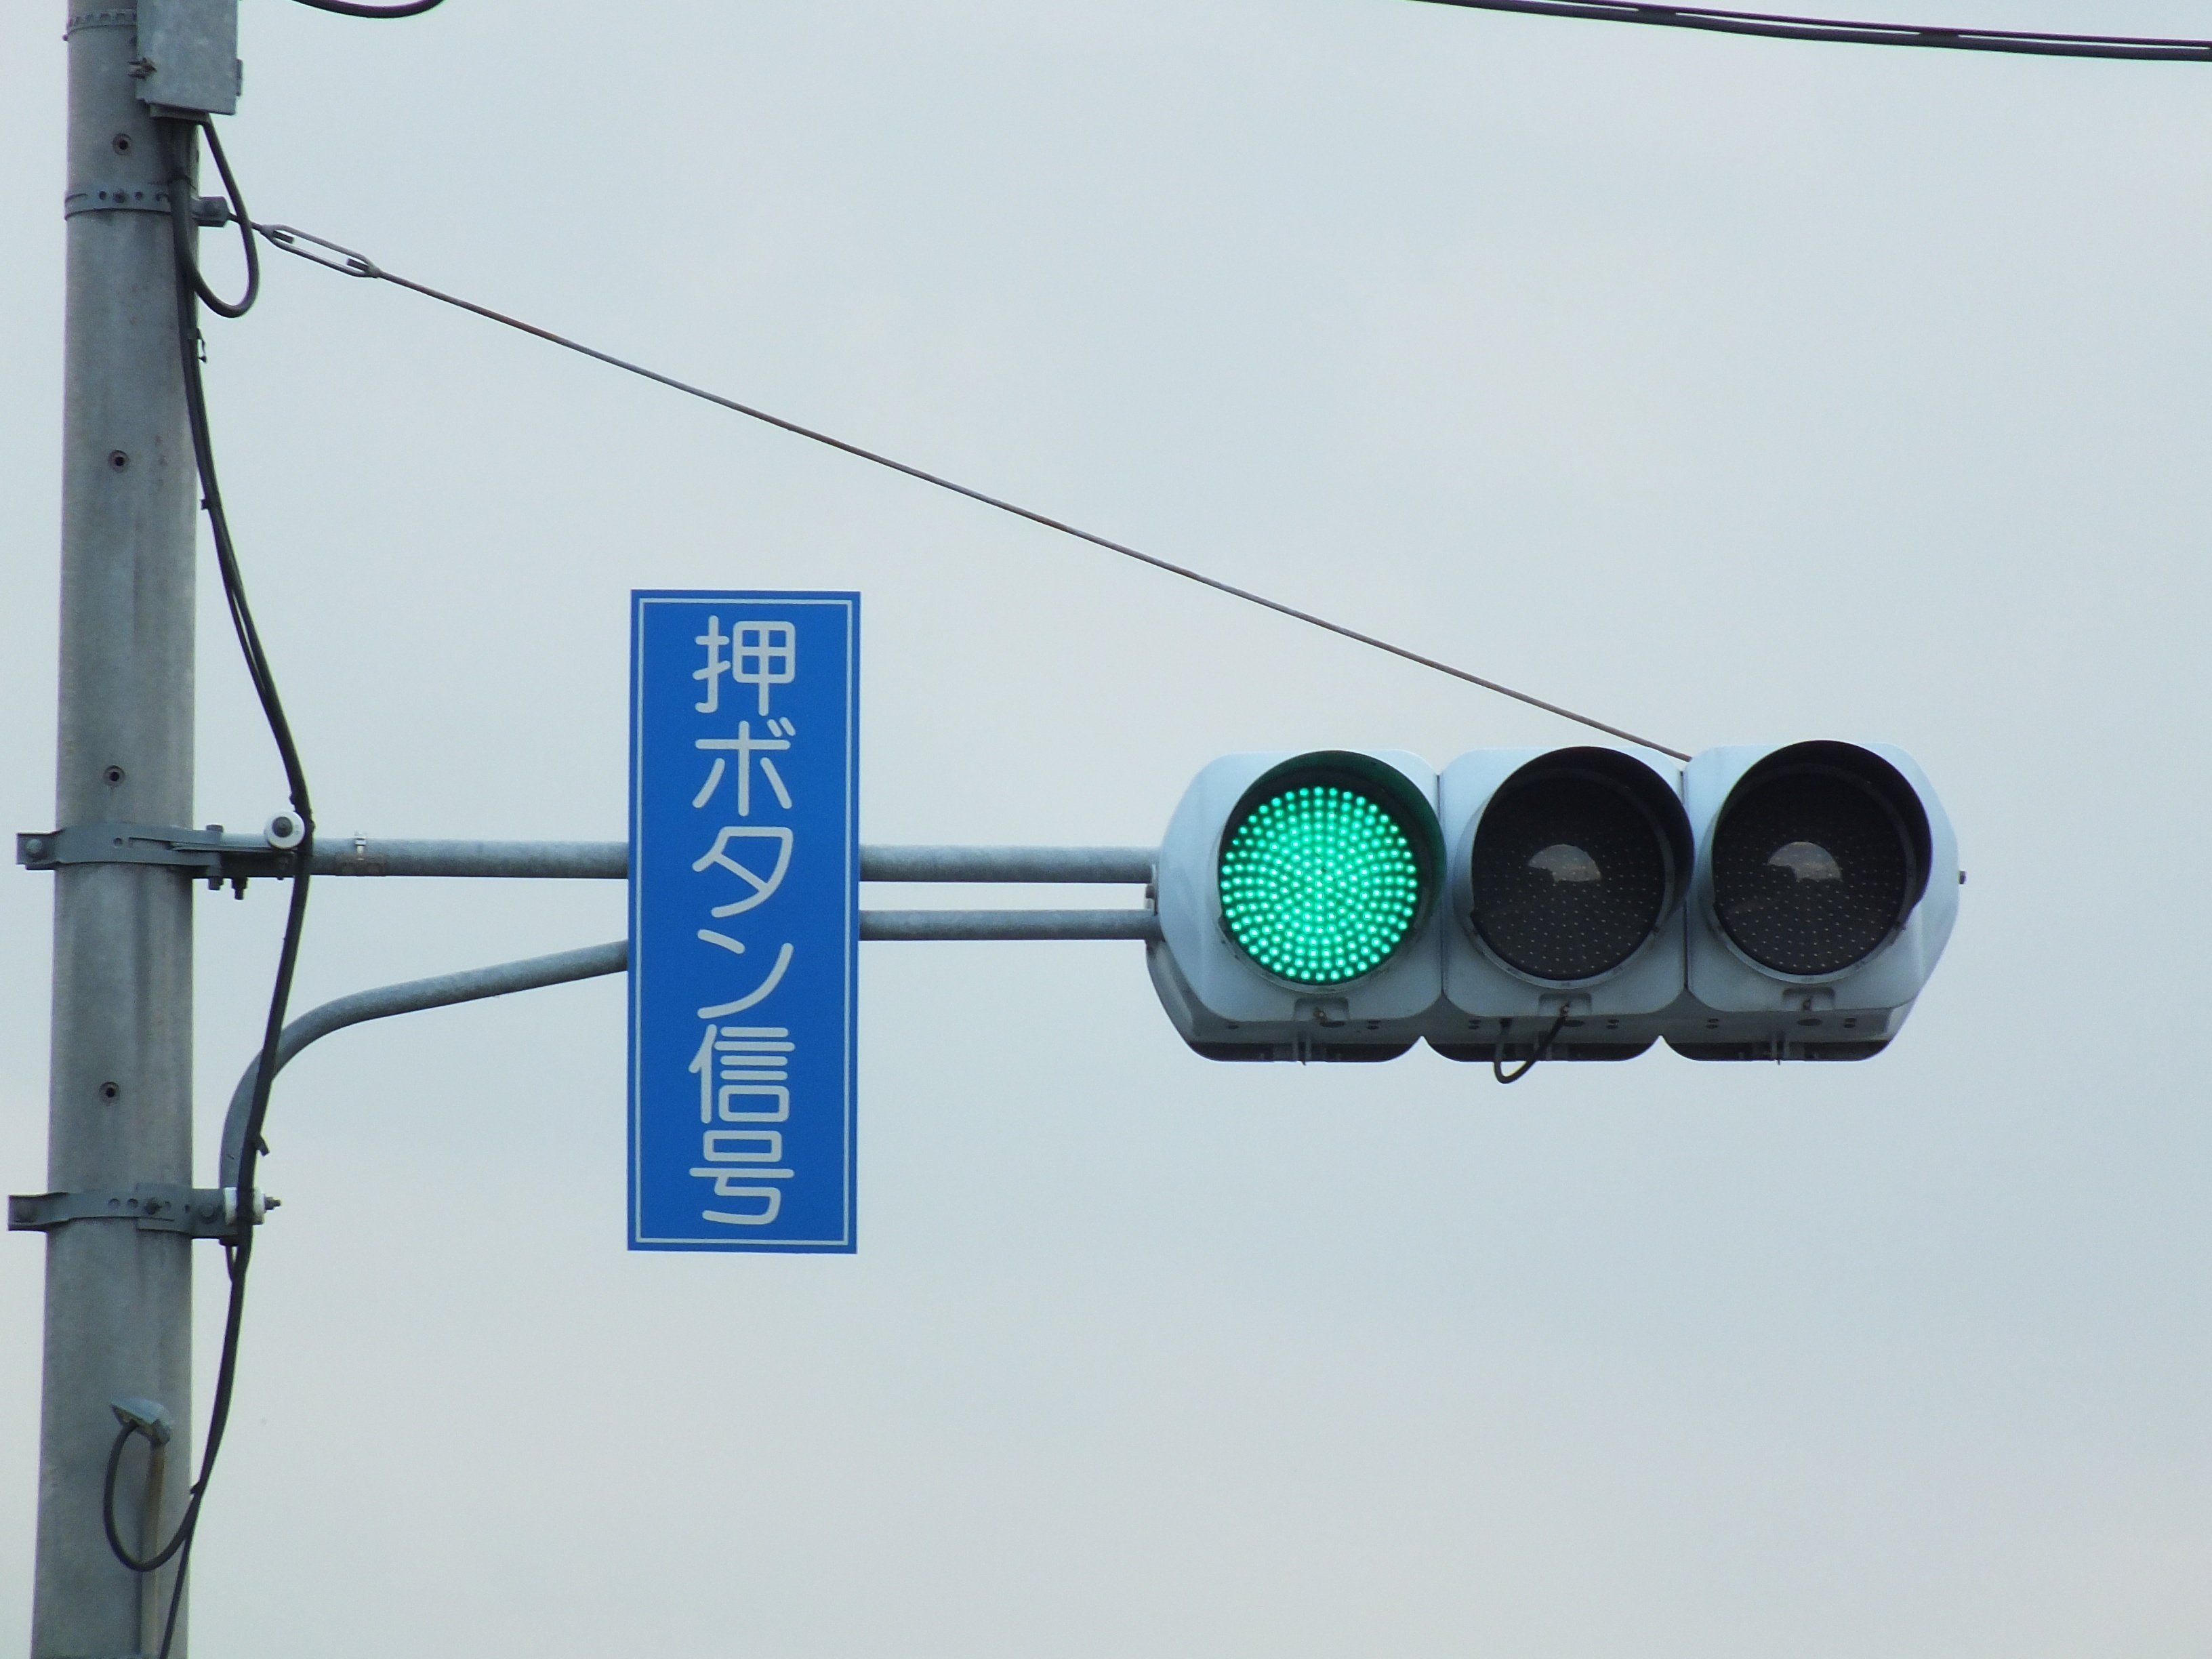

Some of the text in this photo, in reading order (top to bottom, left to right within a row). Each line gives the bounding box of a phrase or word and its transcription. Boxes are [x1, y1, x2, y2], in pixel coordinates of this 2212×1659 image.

[689, 615, 797, 1225] 押ボタン信号
